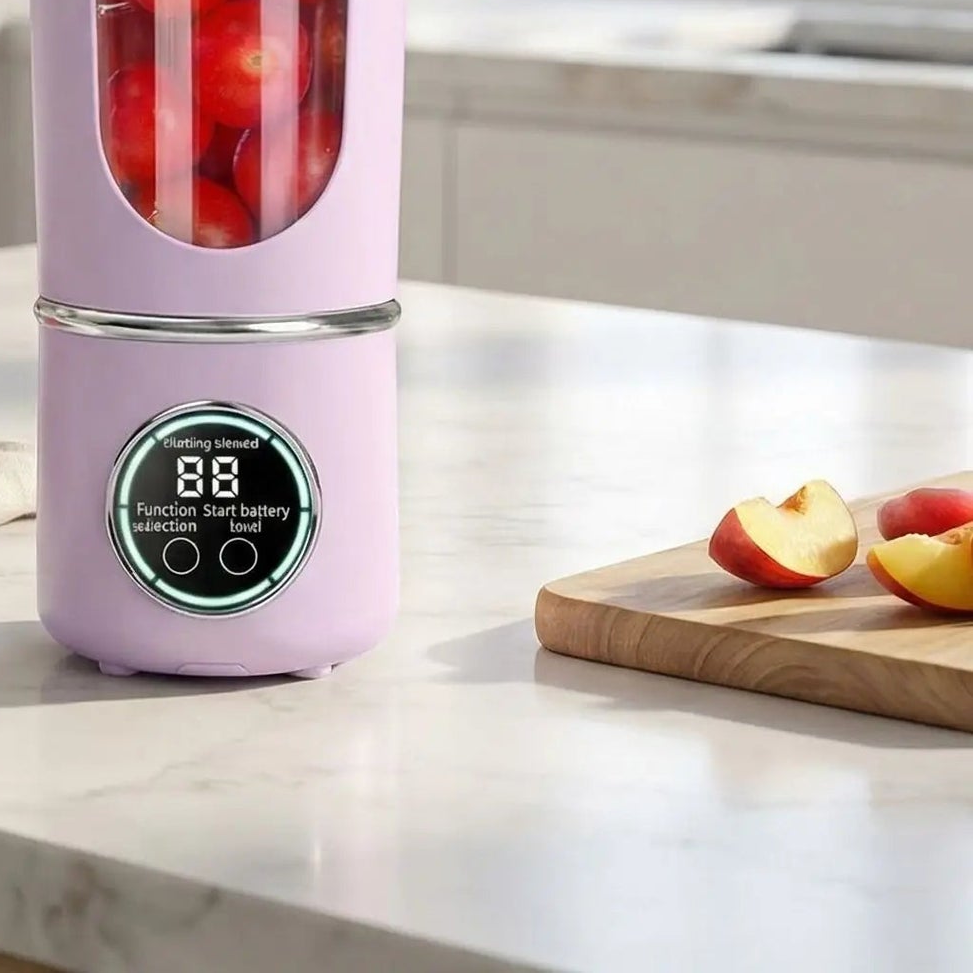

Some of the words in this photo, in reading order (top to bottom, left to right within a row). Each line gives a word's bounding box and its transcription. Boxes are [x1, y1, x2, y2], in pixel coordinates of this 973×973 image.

[177, 456, 239, 498] 88
[137, 501, 196, 517] Function
[203, 503, 237, 517] Start
[240, 502, 290, 521] battery
